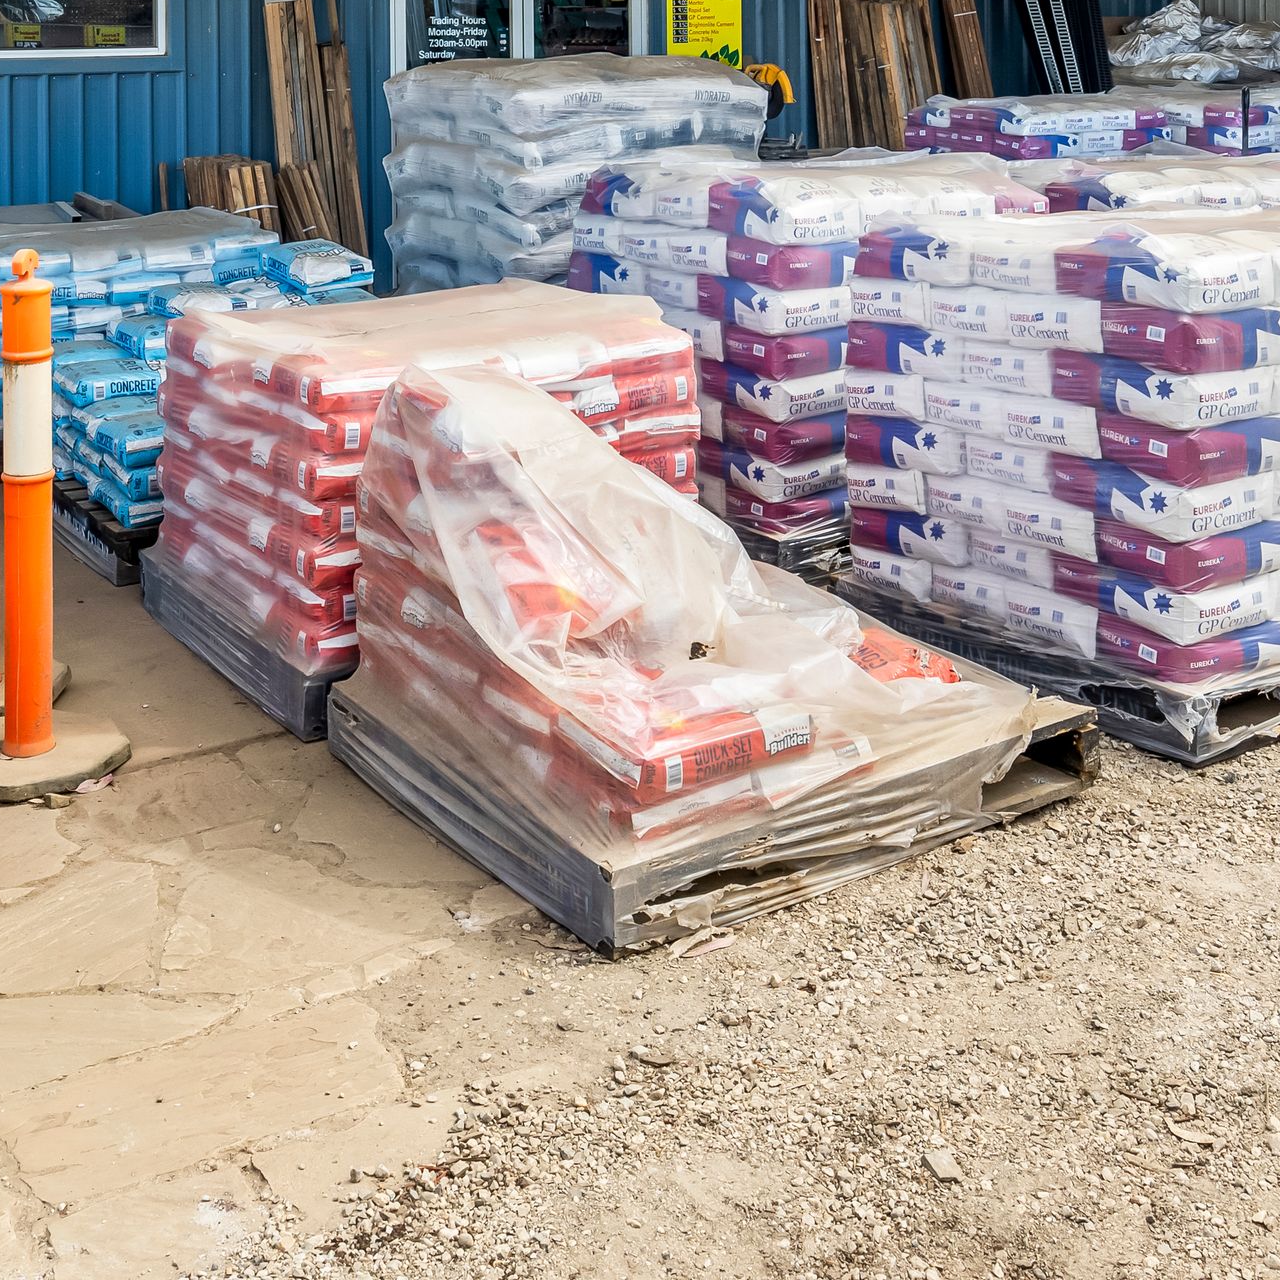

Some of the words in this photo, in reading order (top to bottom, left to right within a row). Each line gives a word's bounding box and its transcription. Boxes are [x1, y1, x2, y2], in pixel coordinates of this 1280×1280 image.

[430, 16, 459, 26] Trading
[462, 16, 486, 24] Hours
[428, 28, 487, 37] Monday-Friday
[419, 50, 455, 60] Saturday
[564, 91, 602, 105] HYDRATED
[694, 89, 730, 102] HYDRATED
[564, 172, 592, 188] HYDRA
[793, 226, 811, 238] GP
[813, 226, 846, 238] Cement
[269, 257, 287, 277] CONCRETE
[976, 255, 1001, 266] EUREKA
[218, 266, 255, 281] CONCRETE
[976, 268, 990, 280] GP
[993, 272, 1031, 288] Cement
[1203, 275, 1230, 287] EUREKA
[78, 292, 105, 300] Builders
[853, 292, 875, 301] EUREKA
[1202, 288, 1219, 304] GP
[1222, 286, 1260, 303] Cement
[786, 305, 813, 315] EUREKA
[853, 302, 866, 315] GP
[867, 304, 902, 318] Cement
[934, 301, 958, 313] EUREKA
[785, 315, 803, 328] GP
[804, 311, 839, 327] Cement
[934, 312, 948, 325] GP
[1010, 313, 1035, 323] EUREKA
[1011, 323, 1026, 337] GP
[1028, 325, 1069, 341] Cement
[110, 379, 156, 394] CONCRETE
[847, 386, 868, 394] EUREKA
[790, 393, 817, 402] EUREKA
[928, 395, 952, 407] EUREKA
[1199, 391, 1229, 403] EUREKA
[584, 404, 616, 417] Builders
[789, 403, 806, 415] GP
[808, 396, 844, 412] Cement
[848, 396, 860, 409] GP
[862, 397, 896, 412] Cement
[1198, 404, 1218, 420] GP
[1220, 399, 1259, 418] Cement
[928, 405, 942, 418] GP
[1008, 413, 1033, 424] EUREKA
[1009, 424, 1024, 439] GP
[1025, 428, 1068, 446] Cement
[1101, 428, 1131, 445] EUREKA
[1200, 451, 1220, 460] EUREKA
[784, 472, 812, 484] EUREKA
[848, 478, 869, 487] EUREKA
[784, 485, 801, 497] GP
[802, 477, 839, 493] Cement
[849, 489, 863, 502] GP
[864, 491, 897, 505] Cement
[930, 488, 953, 500] EUREKA
[931, 499, 945, 512] GP
[1192, 502, 1224, 516] EUREKA
[1007, 510, 1032, 522] EUREKA
[1192, 516, 1212, 532] GP
[1214, 507, 1255, 528] Cement
[1008, 521, 1023, 536] GP
[1024, 527, 1065, 547] Cement
[1198, 557, 1220, 567] EUREKA
[867, 572, 901, 590] Cement
[1008, 602, 1033, 615] EUREKA
[1199, 605, 1232, 619] EUREKA
[1009, 613, 1024, 627] GP
[1026, 618, 1064, 639] Cement
[1198, 618, 1218, 634] GP
[1220, 609, 1262, 631] Cement
[1190, 659, 1214, 668] EUREKA
[694, 736, 752, 766] QUICK-SET
[770, 732, 811, 756] Builders
[646, 764, 656, 785] 20kg
[695, 754, 752, 783] CONCRETE
